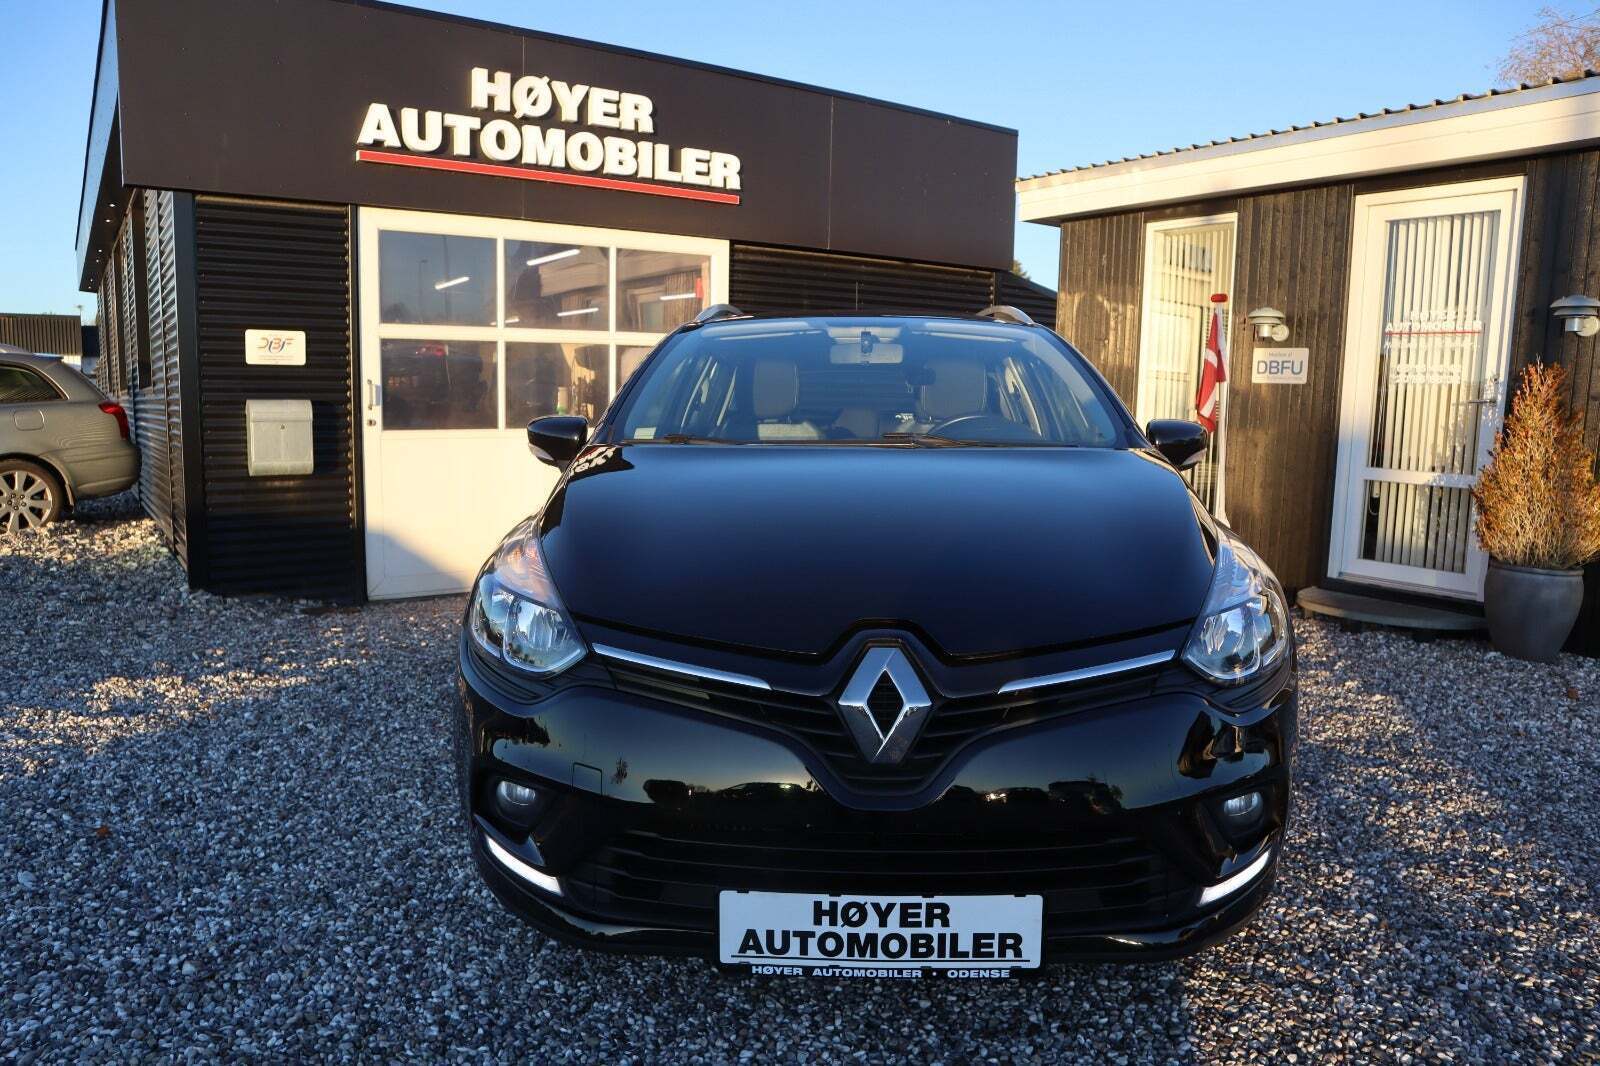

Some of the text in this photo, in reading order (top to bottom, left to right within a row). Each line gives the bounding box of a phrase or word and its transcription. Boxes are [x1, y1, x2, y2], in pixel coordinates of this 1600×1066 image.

[471, 67, 654, 134] HØYER
[356, 102, 742, 191] AUTOMOBILER
[1256, 359, 1304, 376] DBFU
[812, 900, 951, 928] HØYER
[738, 929, 1023, 959] AUTOMOBILER
[751, 965, 1011, 979] HØYER AUTOMOBILER ODENSE
